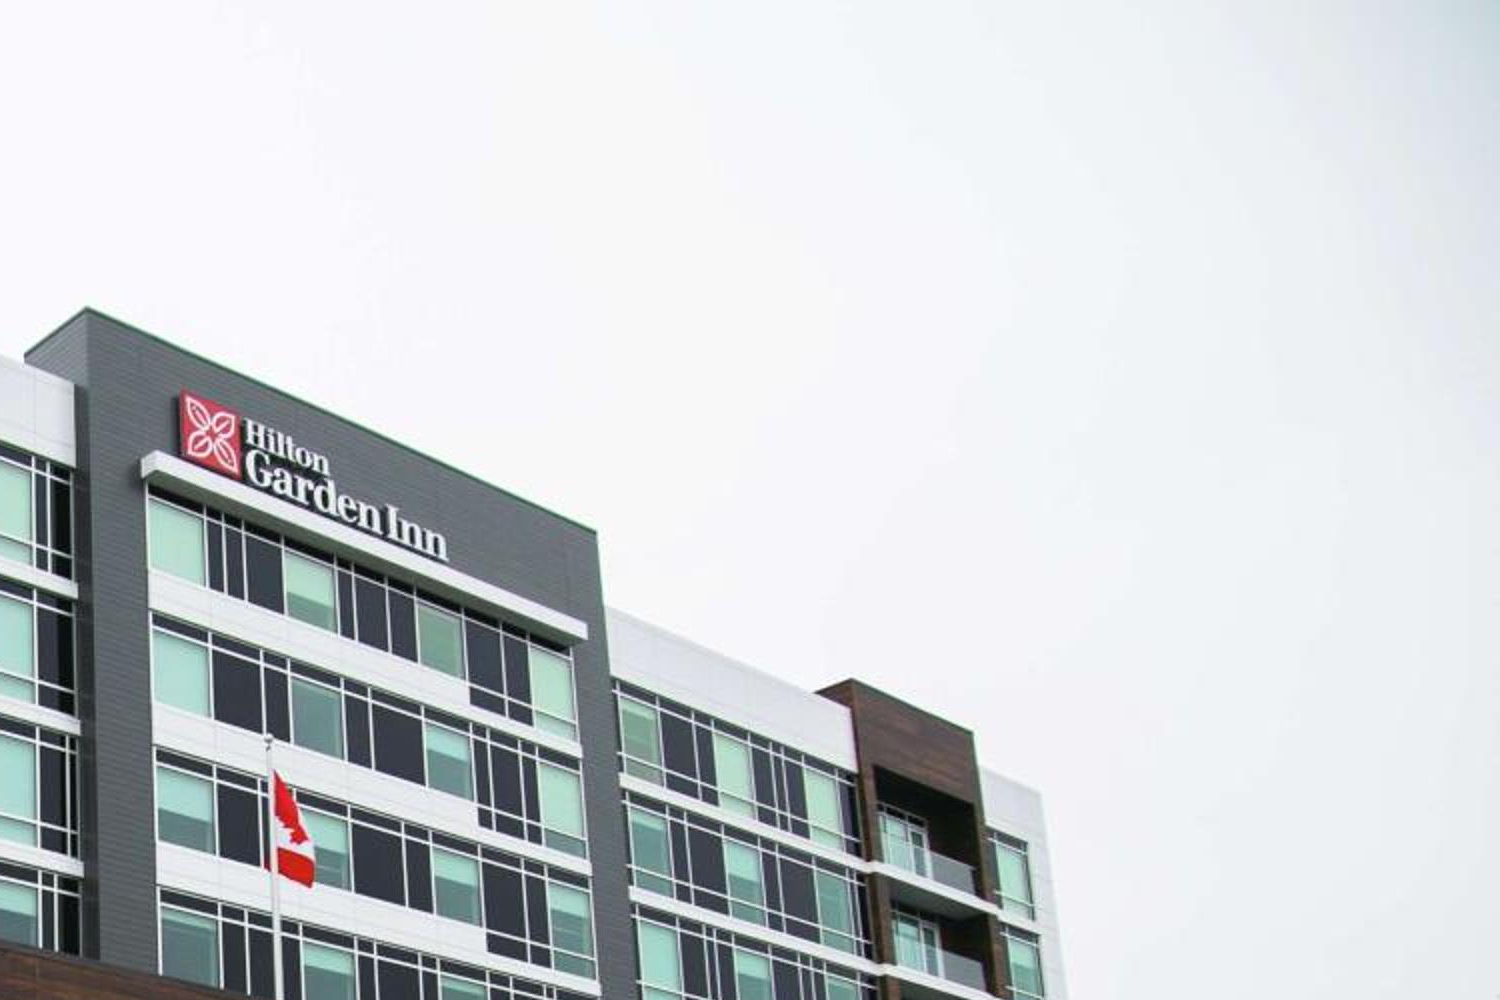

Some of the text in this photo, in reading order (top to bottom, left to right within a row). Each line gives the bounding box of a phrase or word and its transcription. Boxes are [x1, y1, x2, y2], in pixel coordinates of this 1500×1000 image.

[245, 418, 330, 475] Hilton
[245, 449, 449, 562] Garden Inn
